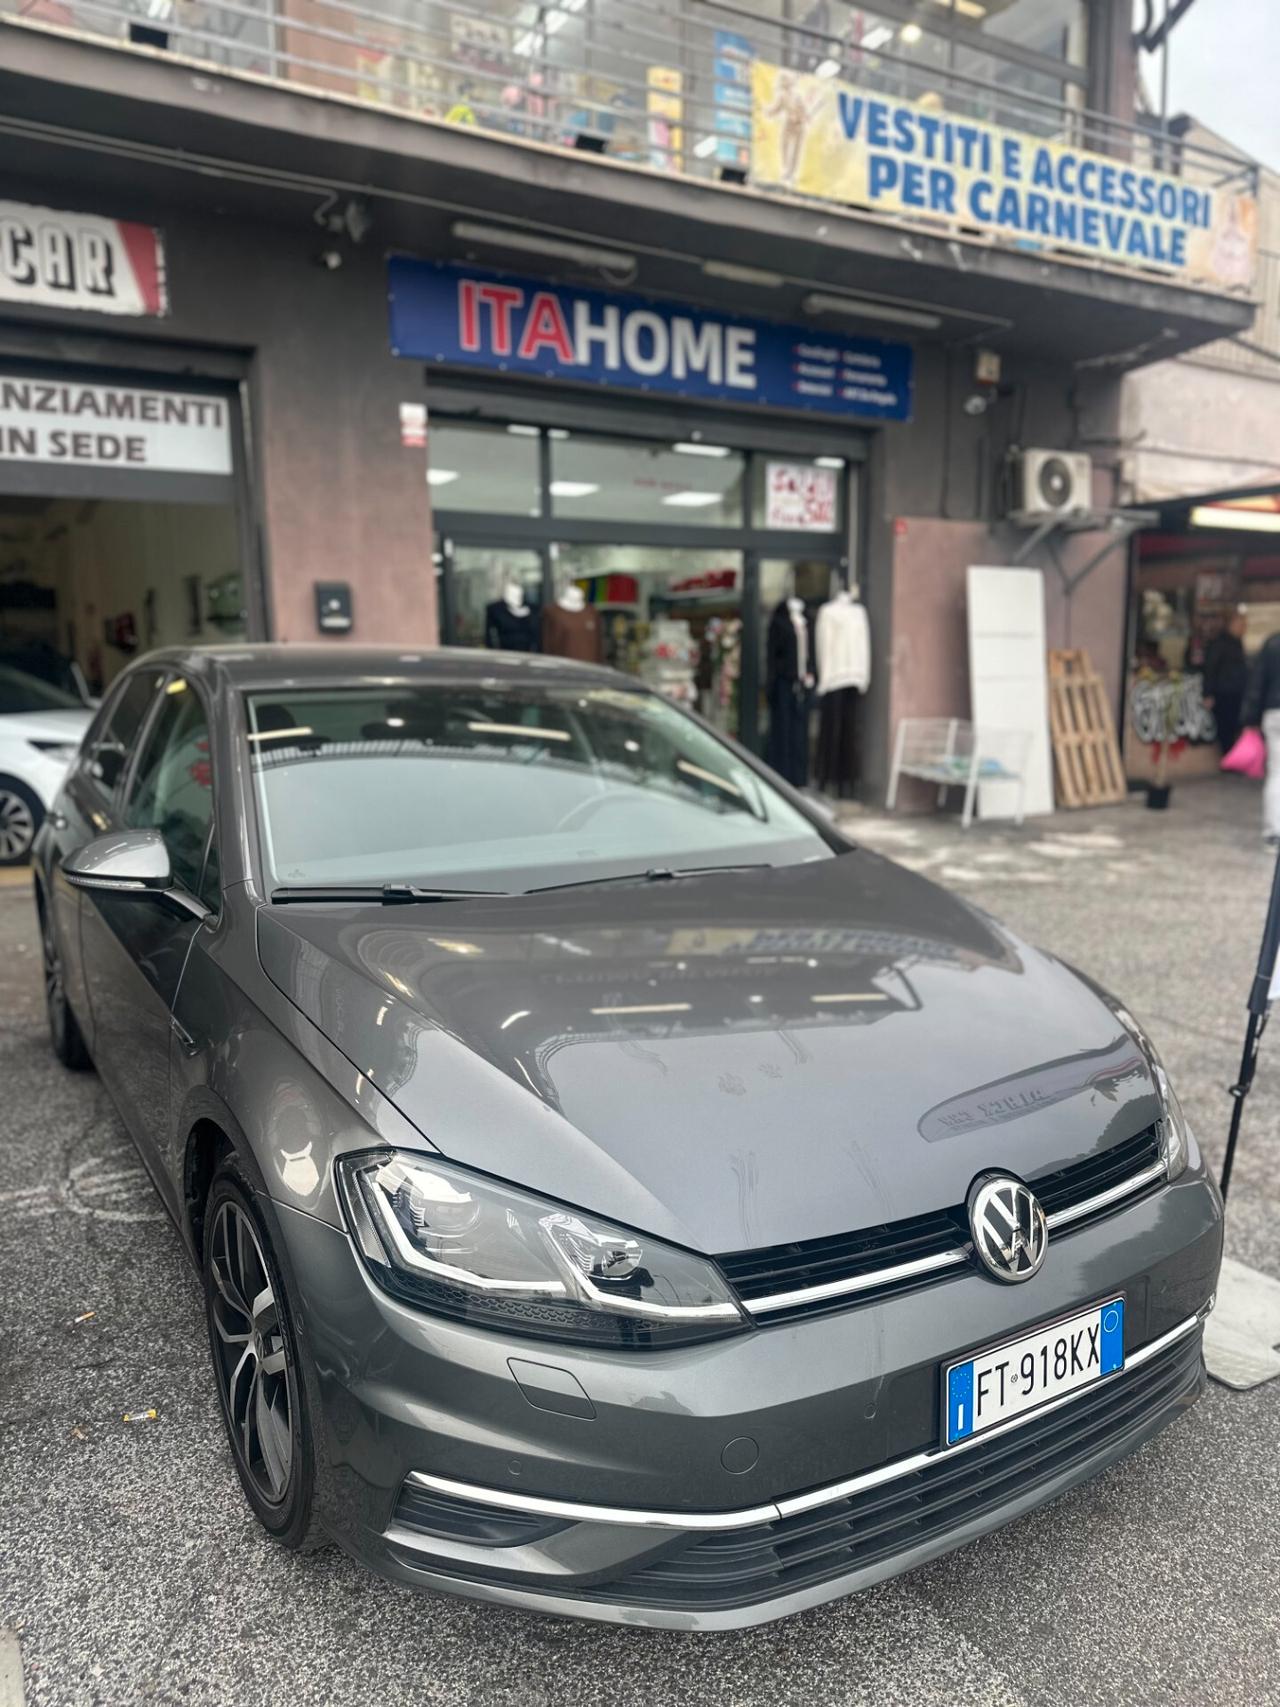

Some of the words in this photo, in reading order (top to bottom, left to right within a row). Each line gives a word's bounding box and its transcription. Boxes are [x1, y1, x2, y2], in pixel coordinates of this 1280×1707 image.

[838, 92, 992, 173] VESTITI
[1003, 138, 1022, 181] E
[1031, 145, 1212, 229] ACCESSORI
[868, 154, 957, 215] PER
[968, 180, 1187, 267] CARNEVALE
[2, 216, 116, 298] CAR
[459, 279, 757, 390] ITAHOME
[49, 429, 146, 462] SEDE
